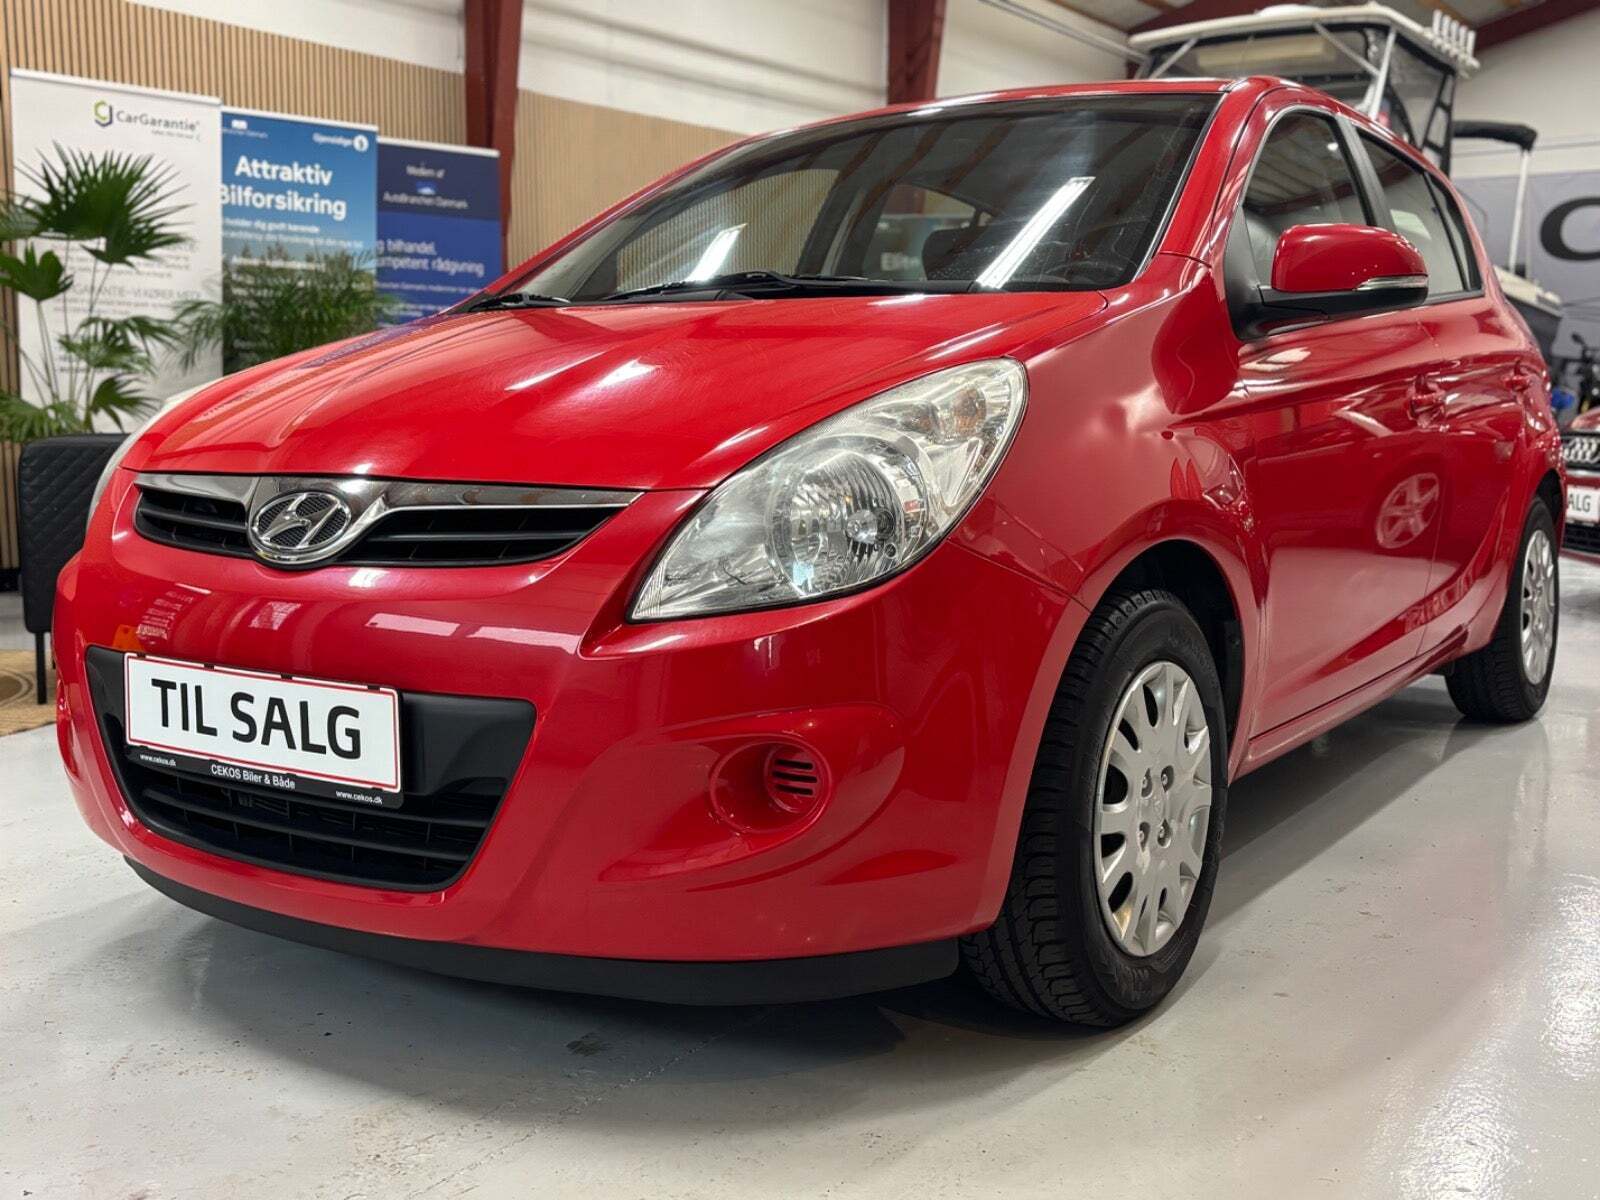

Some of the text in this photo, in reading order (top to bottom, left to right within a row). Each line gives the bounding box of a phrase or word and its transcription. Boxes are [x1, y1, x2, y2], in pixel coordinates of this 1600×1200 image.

[235, 155, 333, 186] Attraktiv
[151, 678, 361, 760] TIL SALG
[210, 763, 296, 790] CEKOS Biler & Både
[335, 790, 383, 805] www.cekos.dk
